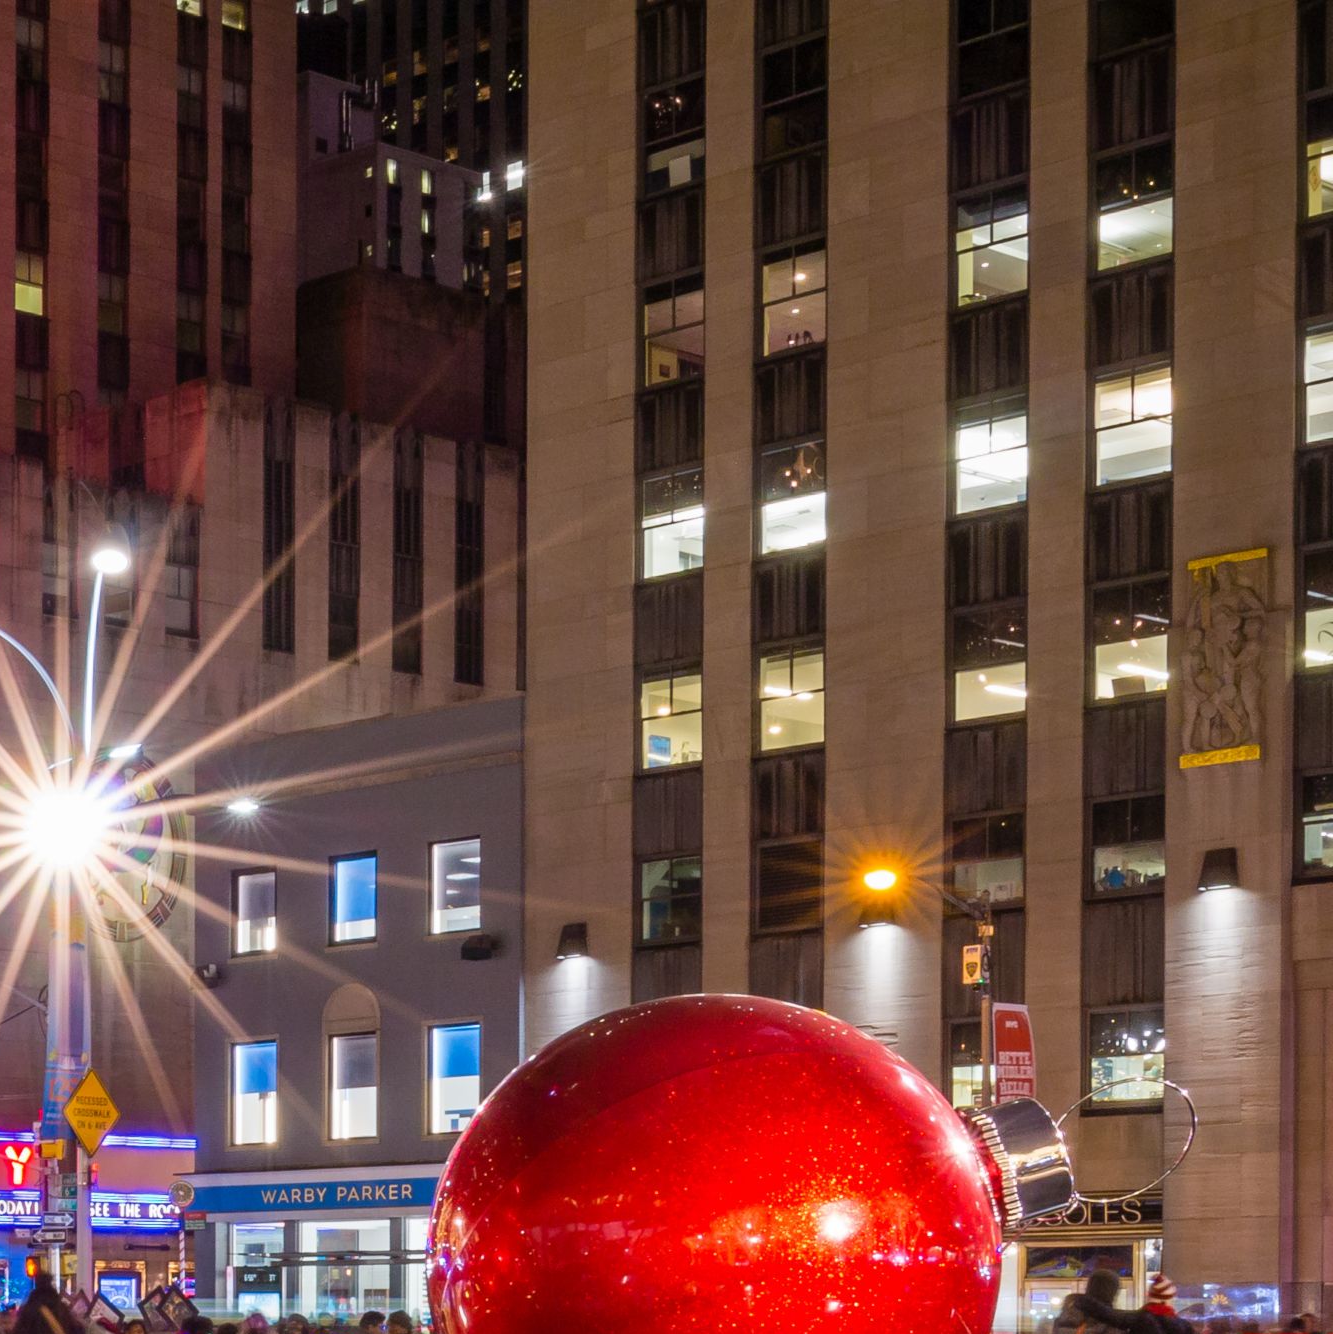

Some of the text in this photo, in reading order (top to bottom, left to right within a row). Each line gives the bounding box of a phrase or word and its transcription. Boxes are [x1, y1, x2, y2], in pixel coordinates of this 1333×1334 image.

[73, 1107, 111, 1118] CROSSWALK
[261, 1184, 413, 1204] WARBY PARKER
[119, 1203, 142, 1218] THE
